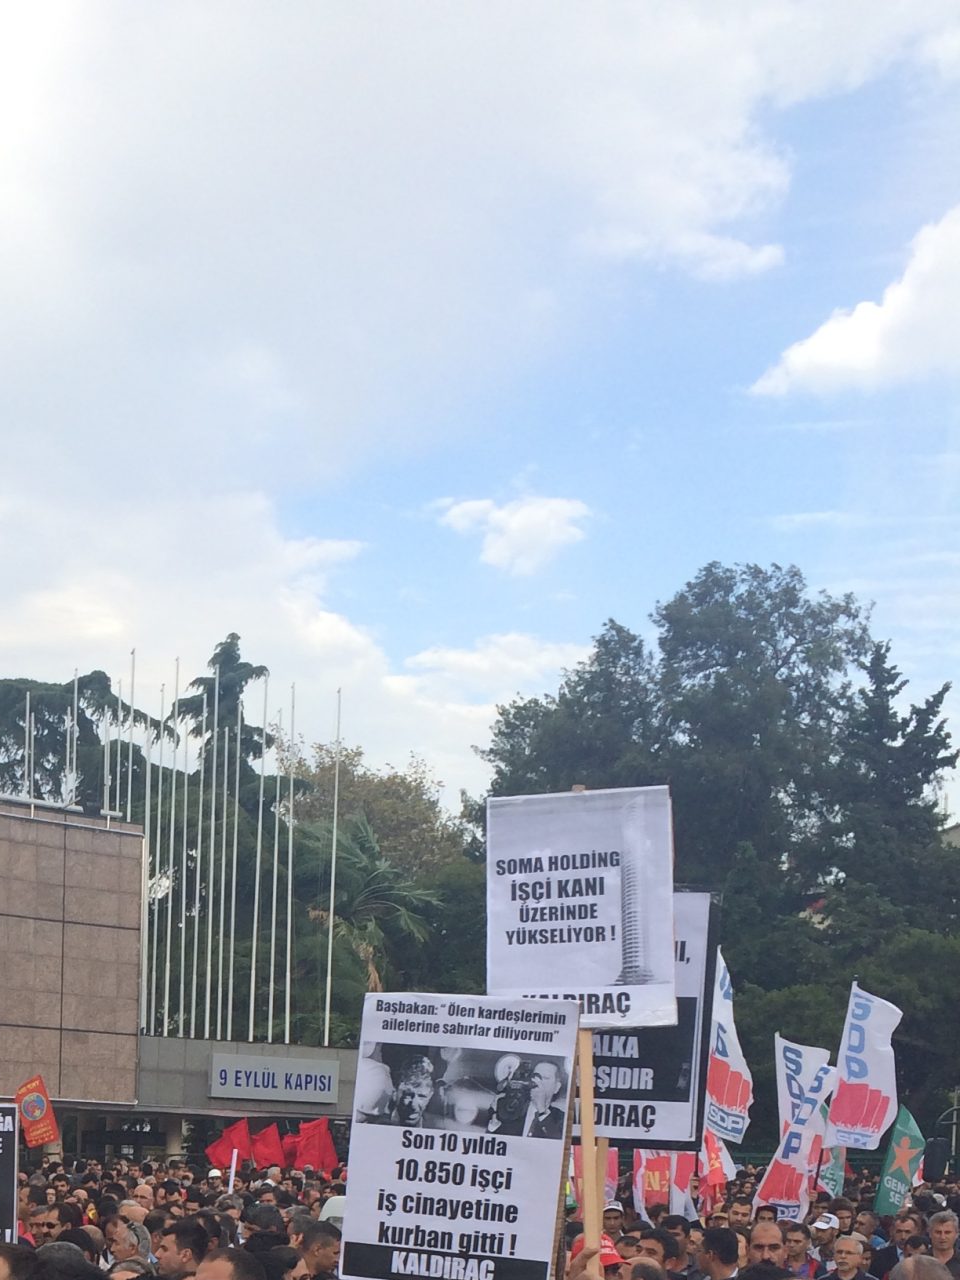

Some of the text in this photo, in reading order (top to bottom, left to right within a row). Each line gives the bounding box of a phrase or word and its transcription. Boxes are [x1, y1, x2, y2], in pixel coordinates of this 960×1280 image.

[495, 850, 621, 876] SOMA HOLDİNG
[510, 877, 605, 903] İŞÇİ KANI
[519, 903, 598, 923] ÜZERİNDE
[505, 925, 606, 946] YÜKSELİYOR
[376, 1000, 438, 1016] Başbakan:
[478, 1006, 567, 1026] kardeşlerimin
[382, 1017, 440, 1034] ailelerine
[442, 1023, 491, 1038] sabırlar
[219, 1067, 331, 1092] 9 EYLÜL KAPISI
[402, 1130, 507, 1157] Son 10 yılda
[395, 1159, 513, 1193] 10.850 işçi
[377, 1189, 518, 1224] iş cinayetine
[378, 1221, 453, 1251] kurban
[458, 1234, 504, 1256] gitti
